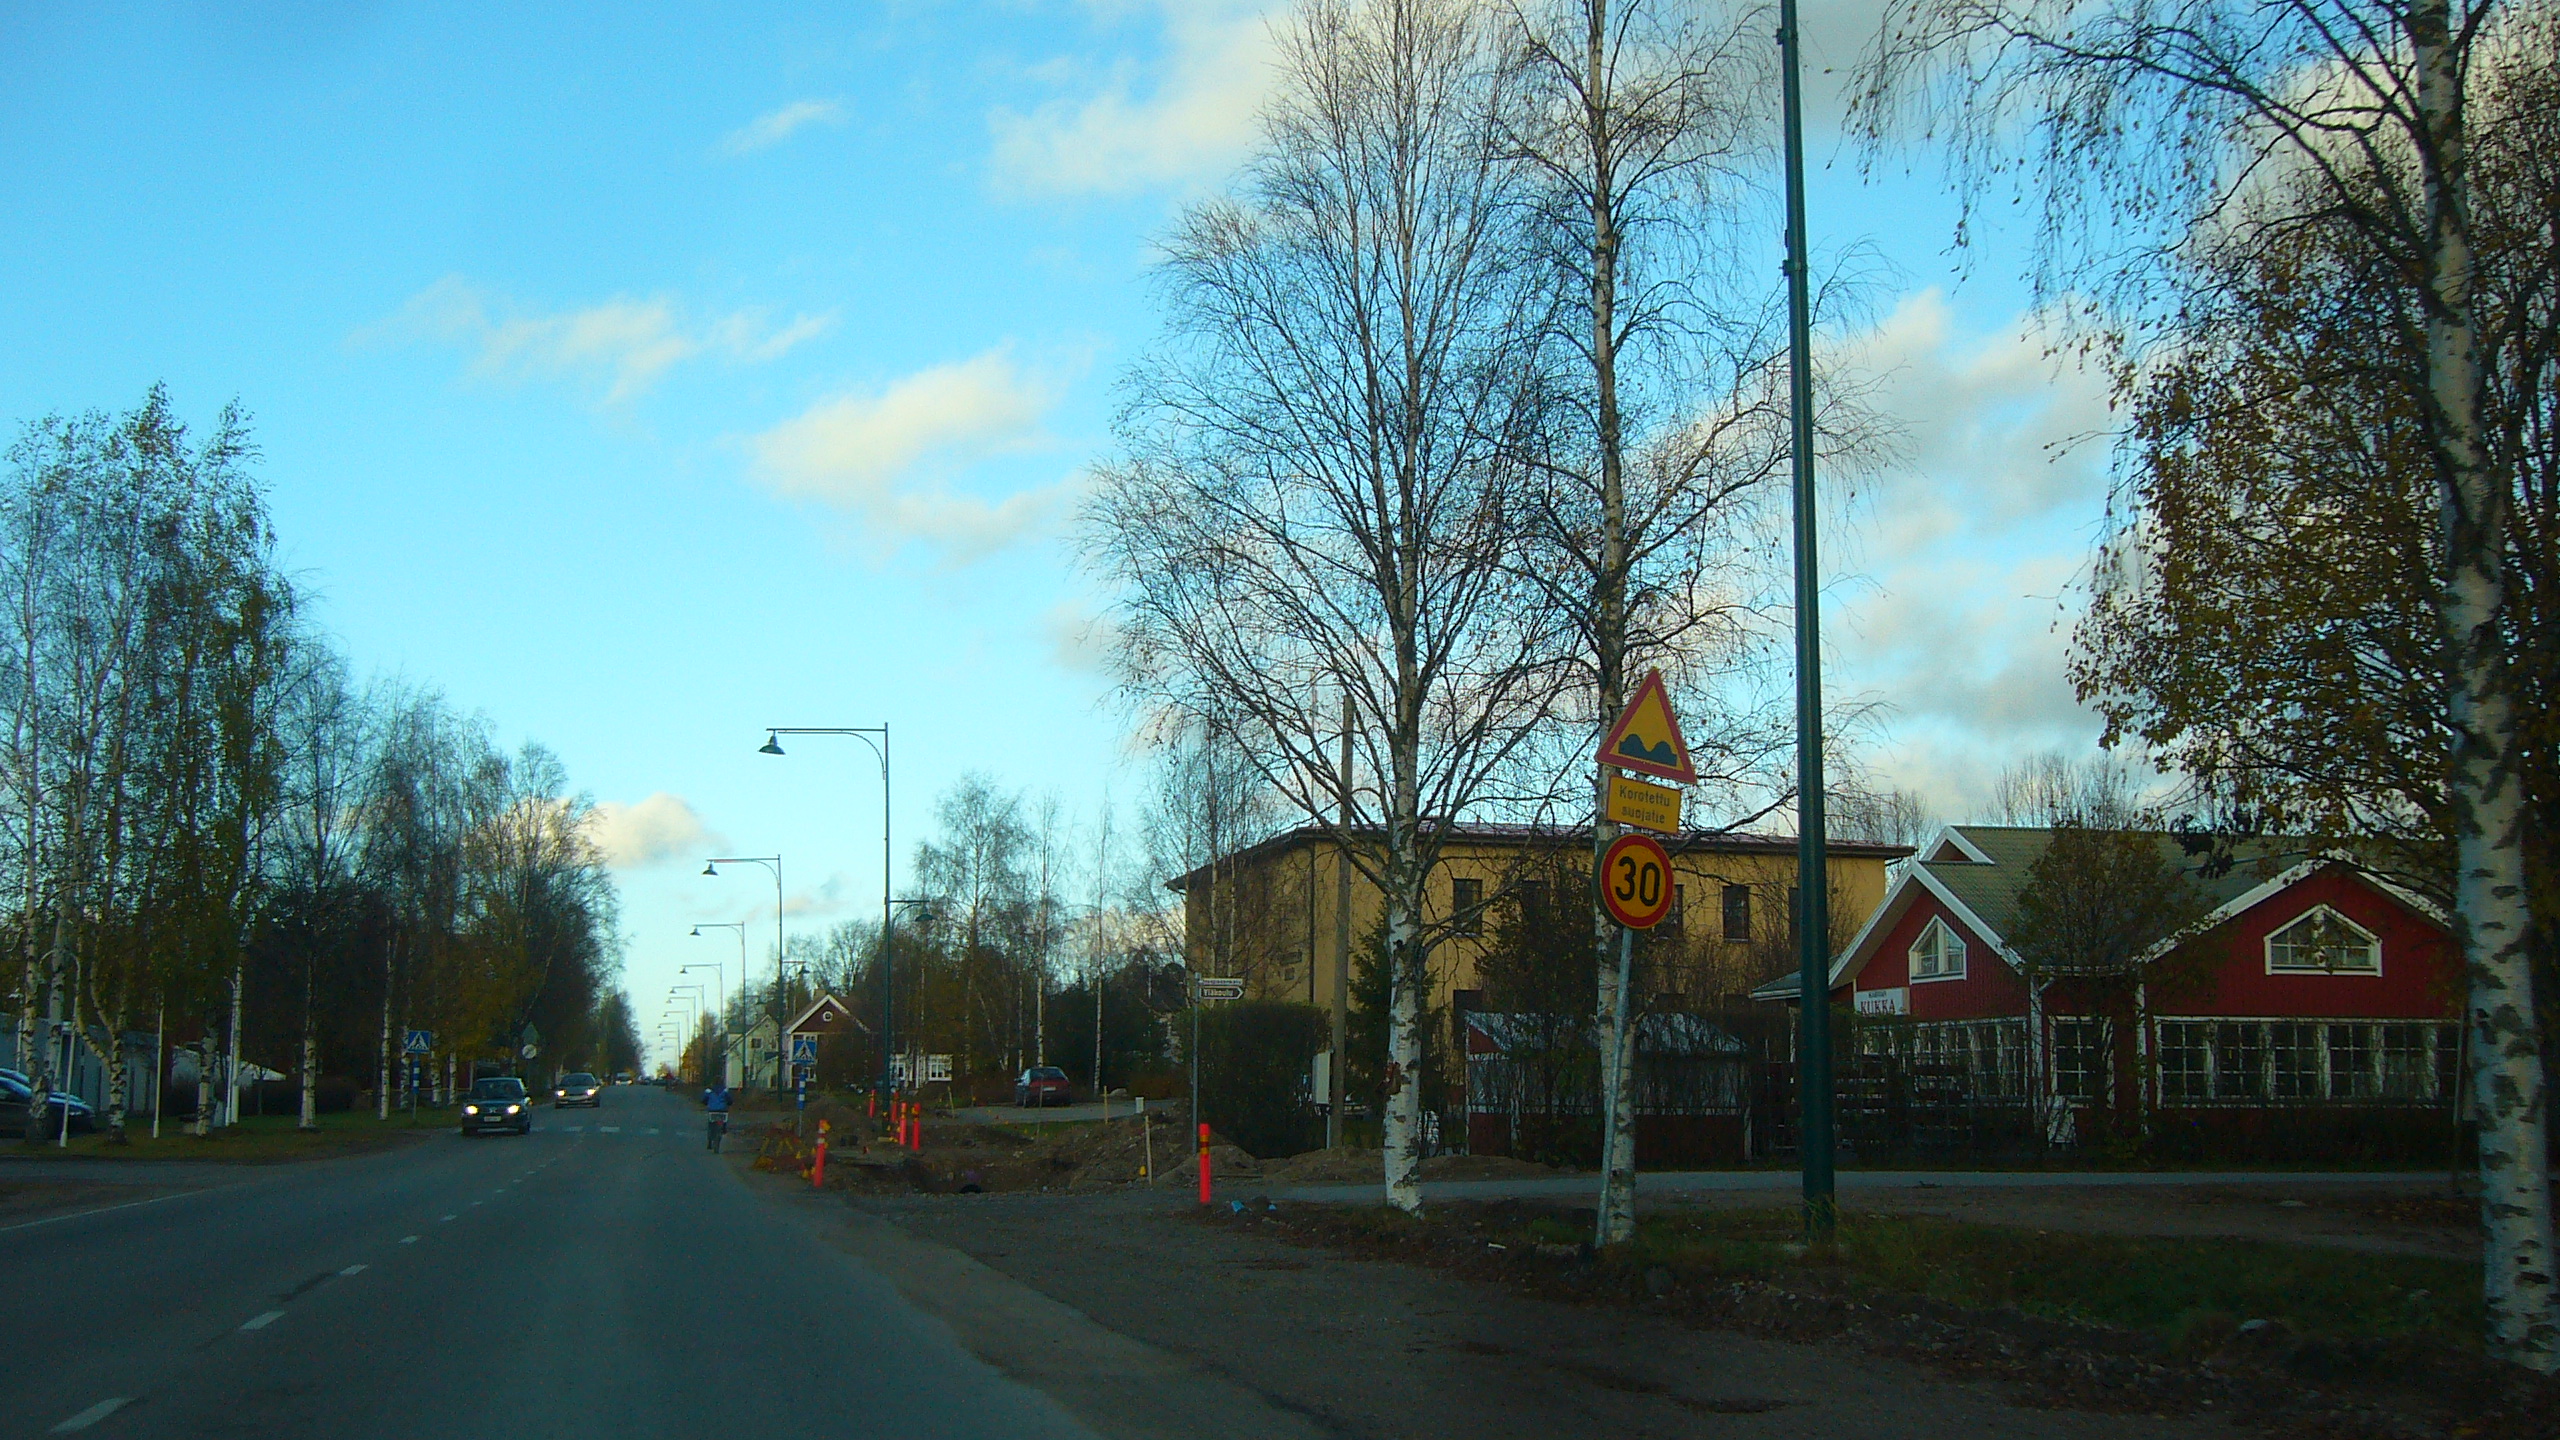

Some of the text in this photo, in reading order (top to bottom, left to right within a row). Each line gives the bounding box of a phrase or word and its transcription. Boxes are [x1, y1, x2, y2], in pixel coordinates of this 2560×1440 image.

[1619, 785, 1670, 807] Korotettu
[1622, 806, 1665, 824] suojatie
[1615, 856, 1660, 907] 30
[1860, 999, 1895, 1016] KUKKA
